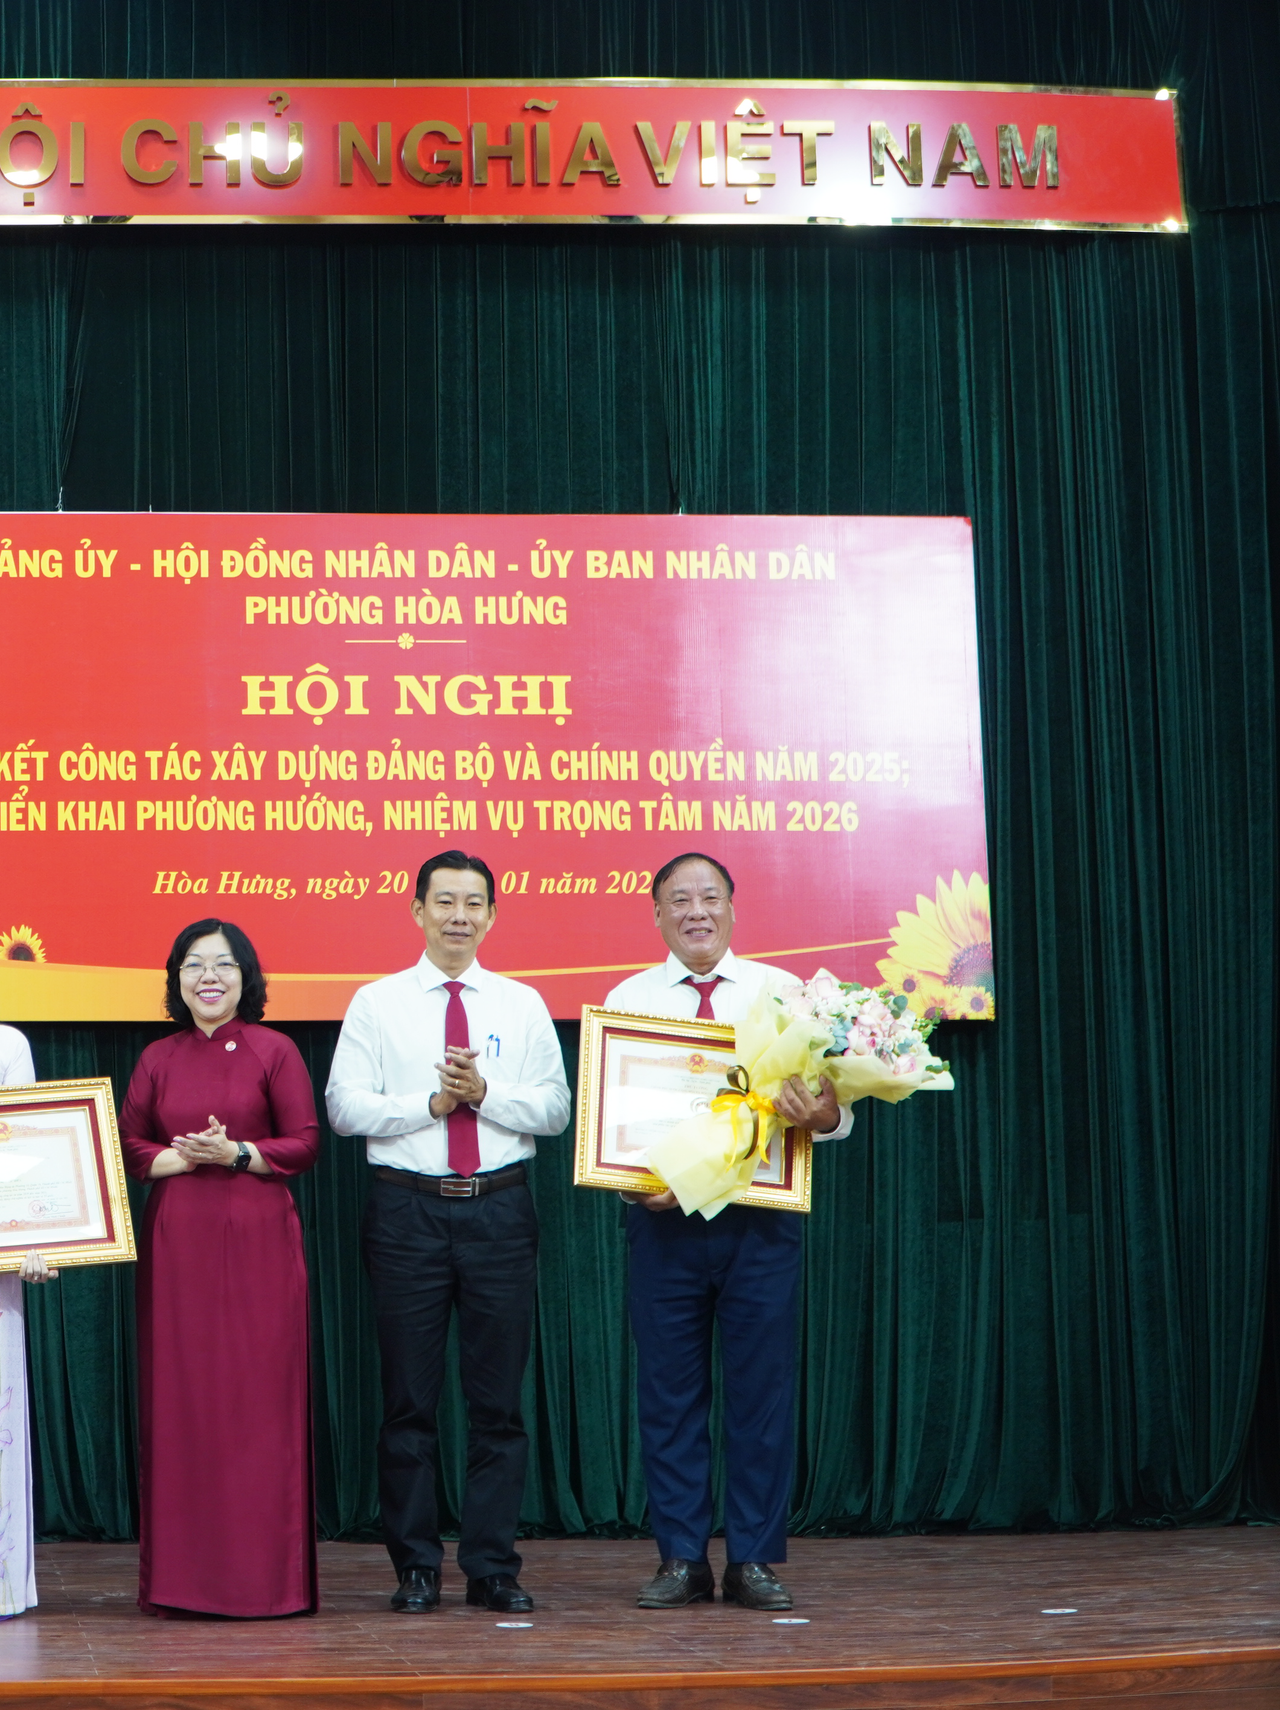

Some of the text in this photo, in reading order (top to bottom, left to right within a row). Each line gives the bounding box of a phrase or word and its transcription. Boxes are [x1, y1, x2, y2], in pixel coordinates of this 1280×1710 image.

[120, 91, 304, 187] CHỦ
[338, 98, 621, 187] NGHĨA
[634, 98, 836, 205] VIỆT
[868, 121, 1060, 188] NAM
[74, 538, 118, 579] ỦY
[153, 541, 210, 585] HỘI
[221, 537, 314, 579] ĐỒNG
[324, 541, 416, 579] NHÂN
[427, 542, 496, 578] DÂN
[530, 538, 574, 579] ỦY
[586, 550, 654, 579] BAN
[666, 543, 756, 580] NHÂN
[768, 543, 837, 581] DÂN
[245, 588, 568, 625] PHƯỜNG HÒA HƯNG
[241, 662, 573, 726] HỘI NGHỊ
[59, 743, 137, 781] CÔNG
[144, 743, 202, 781] TÁC
[210, 742, 267, 781] XÂY
[277, 744, 358, 788] DỰNG
[366, 738, 446, 781] ĐẢNG
[454, 742, 495, 787] BỘ
[502, 742, 542, 781] VÀ
[550, 742, 639, 781] CHÍNH
[648, 737, 745, 787] QUYỀN
[755, 745, 818, 782] NĂM
[828, 751, 910, 788] 2025;
[57, 800, 125, 831] KHAI
[136, 794, 255, 831] PHƯƠNG
[264, 793, 373, 836] HƯỚNG,
[383, 792, 477, 837] NHIỆM
[486, 801, 524, 837] VỤ
[533, 800, 632, 837] TRỌNG
[638, 793, 703, 831] TÂM
[712, 794, 777, 831] NĂM
[786, 800, 859, 832] 2026
[152, 870, 652, 900] Hòa Hưng, ngày 20 01 năm 202
